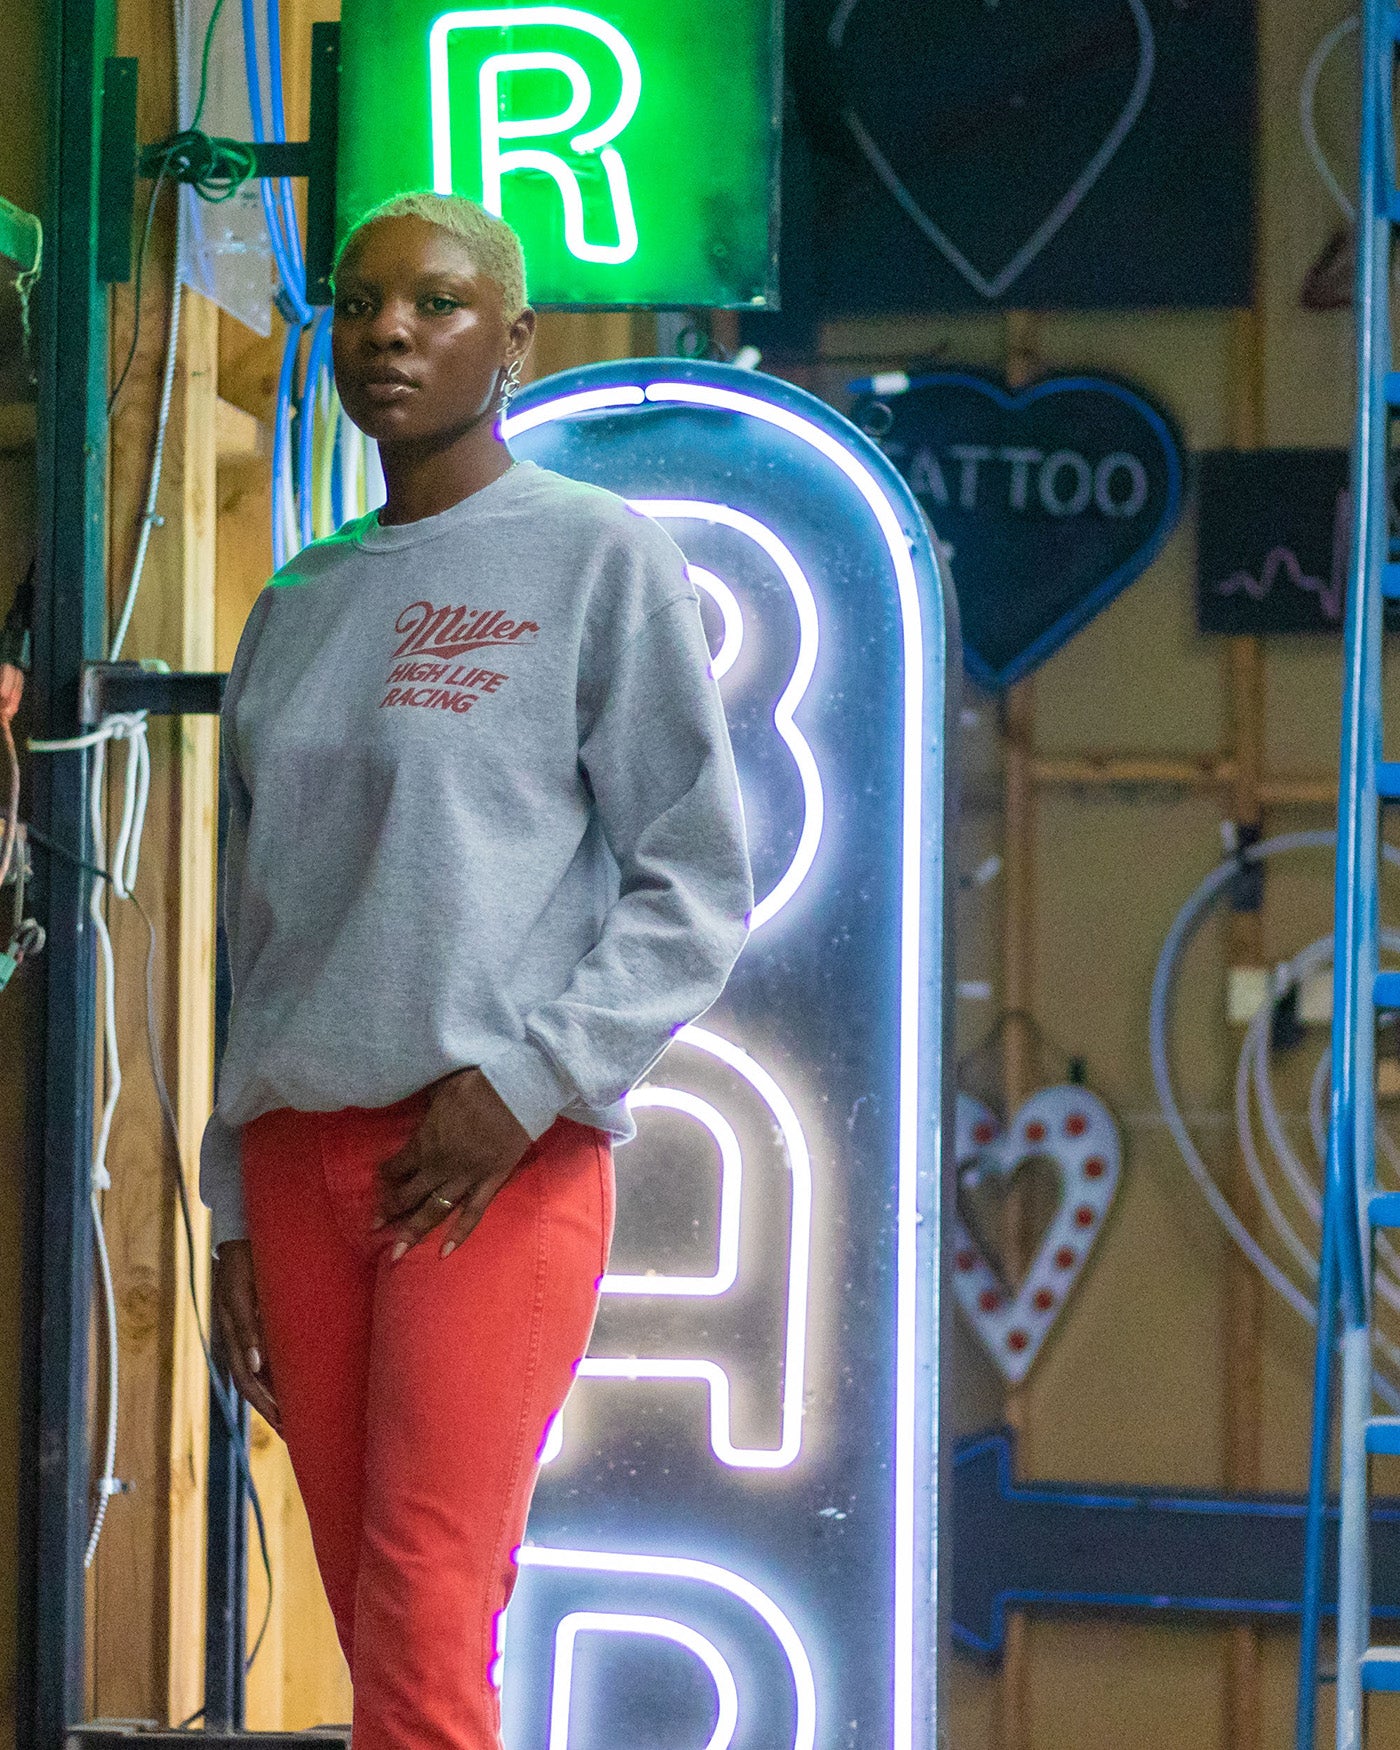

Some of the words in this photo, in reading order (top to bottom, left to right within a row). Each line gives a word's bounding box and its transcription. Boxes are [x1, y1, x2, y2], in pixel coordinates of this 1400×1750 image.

[429, 6, 642, 265] R
[882, 443, 1149, 517] ATTOO
[389, 600, 541, 661] Miller
[379, 686, 480, 714] RACING
[384, 662, 452, 685] HIGH
[444, 665, 510, 694] LIFE
